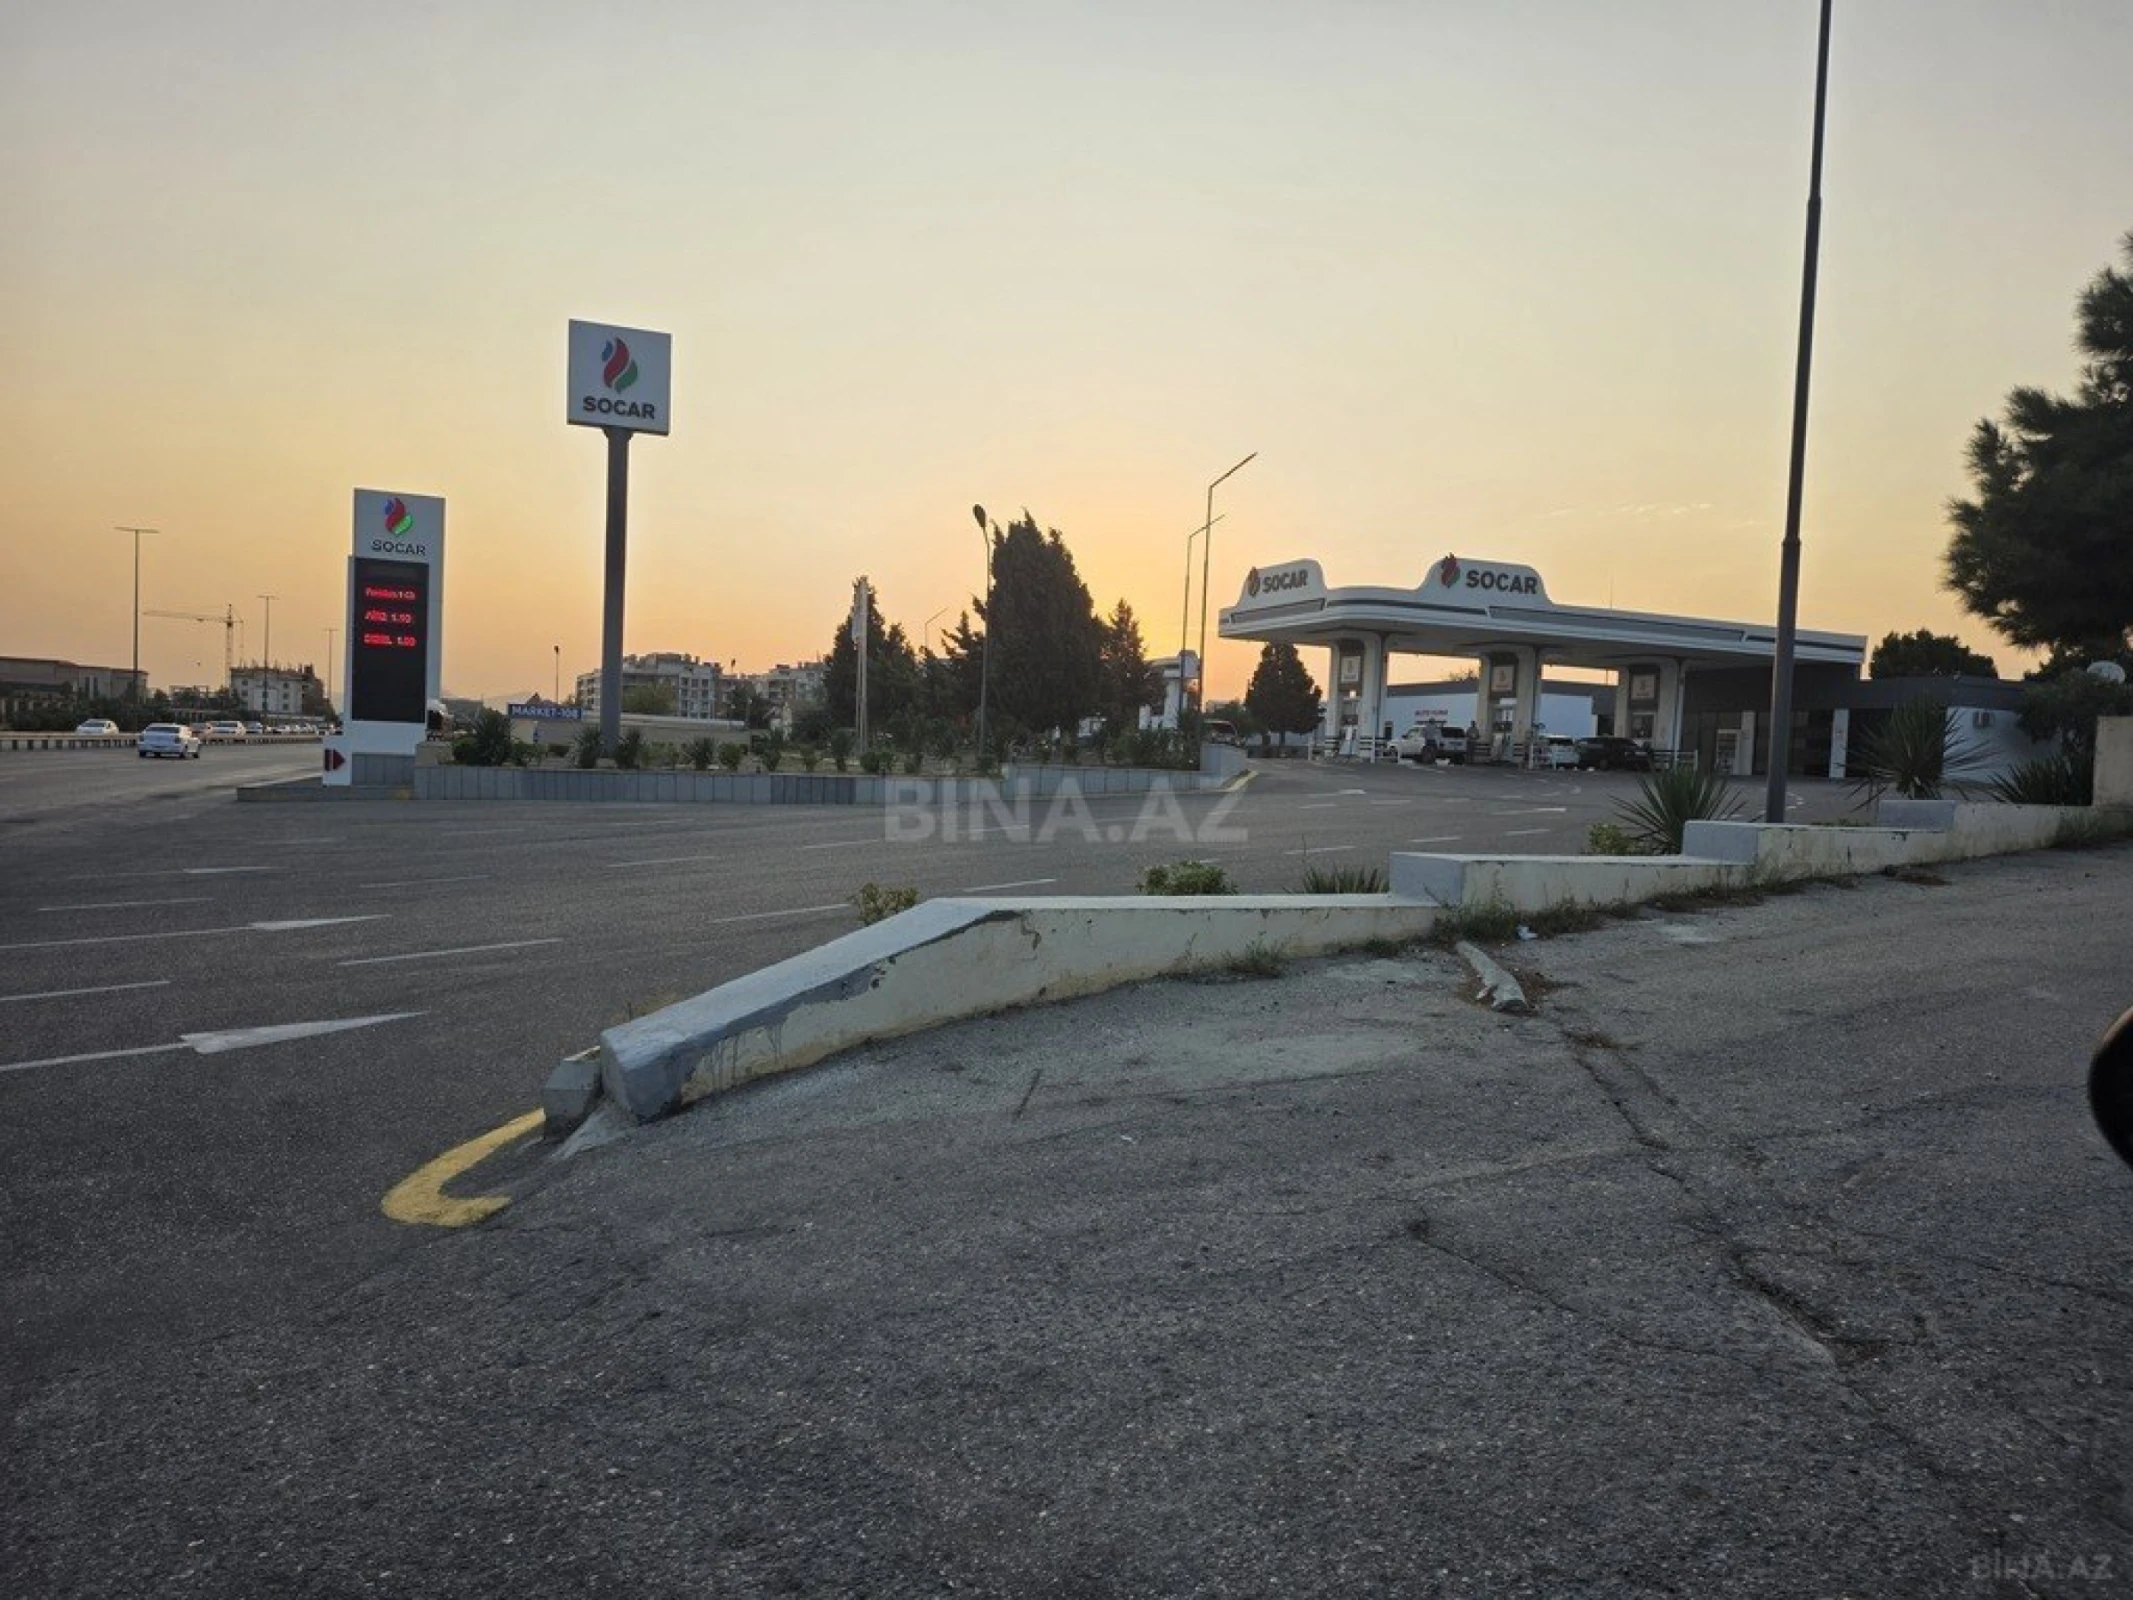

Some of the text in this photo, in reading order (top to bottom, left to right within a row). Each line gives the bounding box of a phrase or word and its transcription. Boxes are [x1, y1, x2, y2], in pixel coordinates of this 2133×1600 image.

[583, 395, 655, 420] SOCAR
[371, 539, 426, 556] SOCAR
[1262, 569, 1308, 594] SOCAR
[1465, 570, 1538, 595] SOCAR
